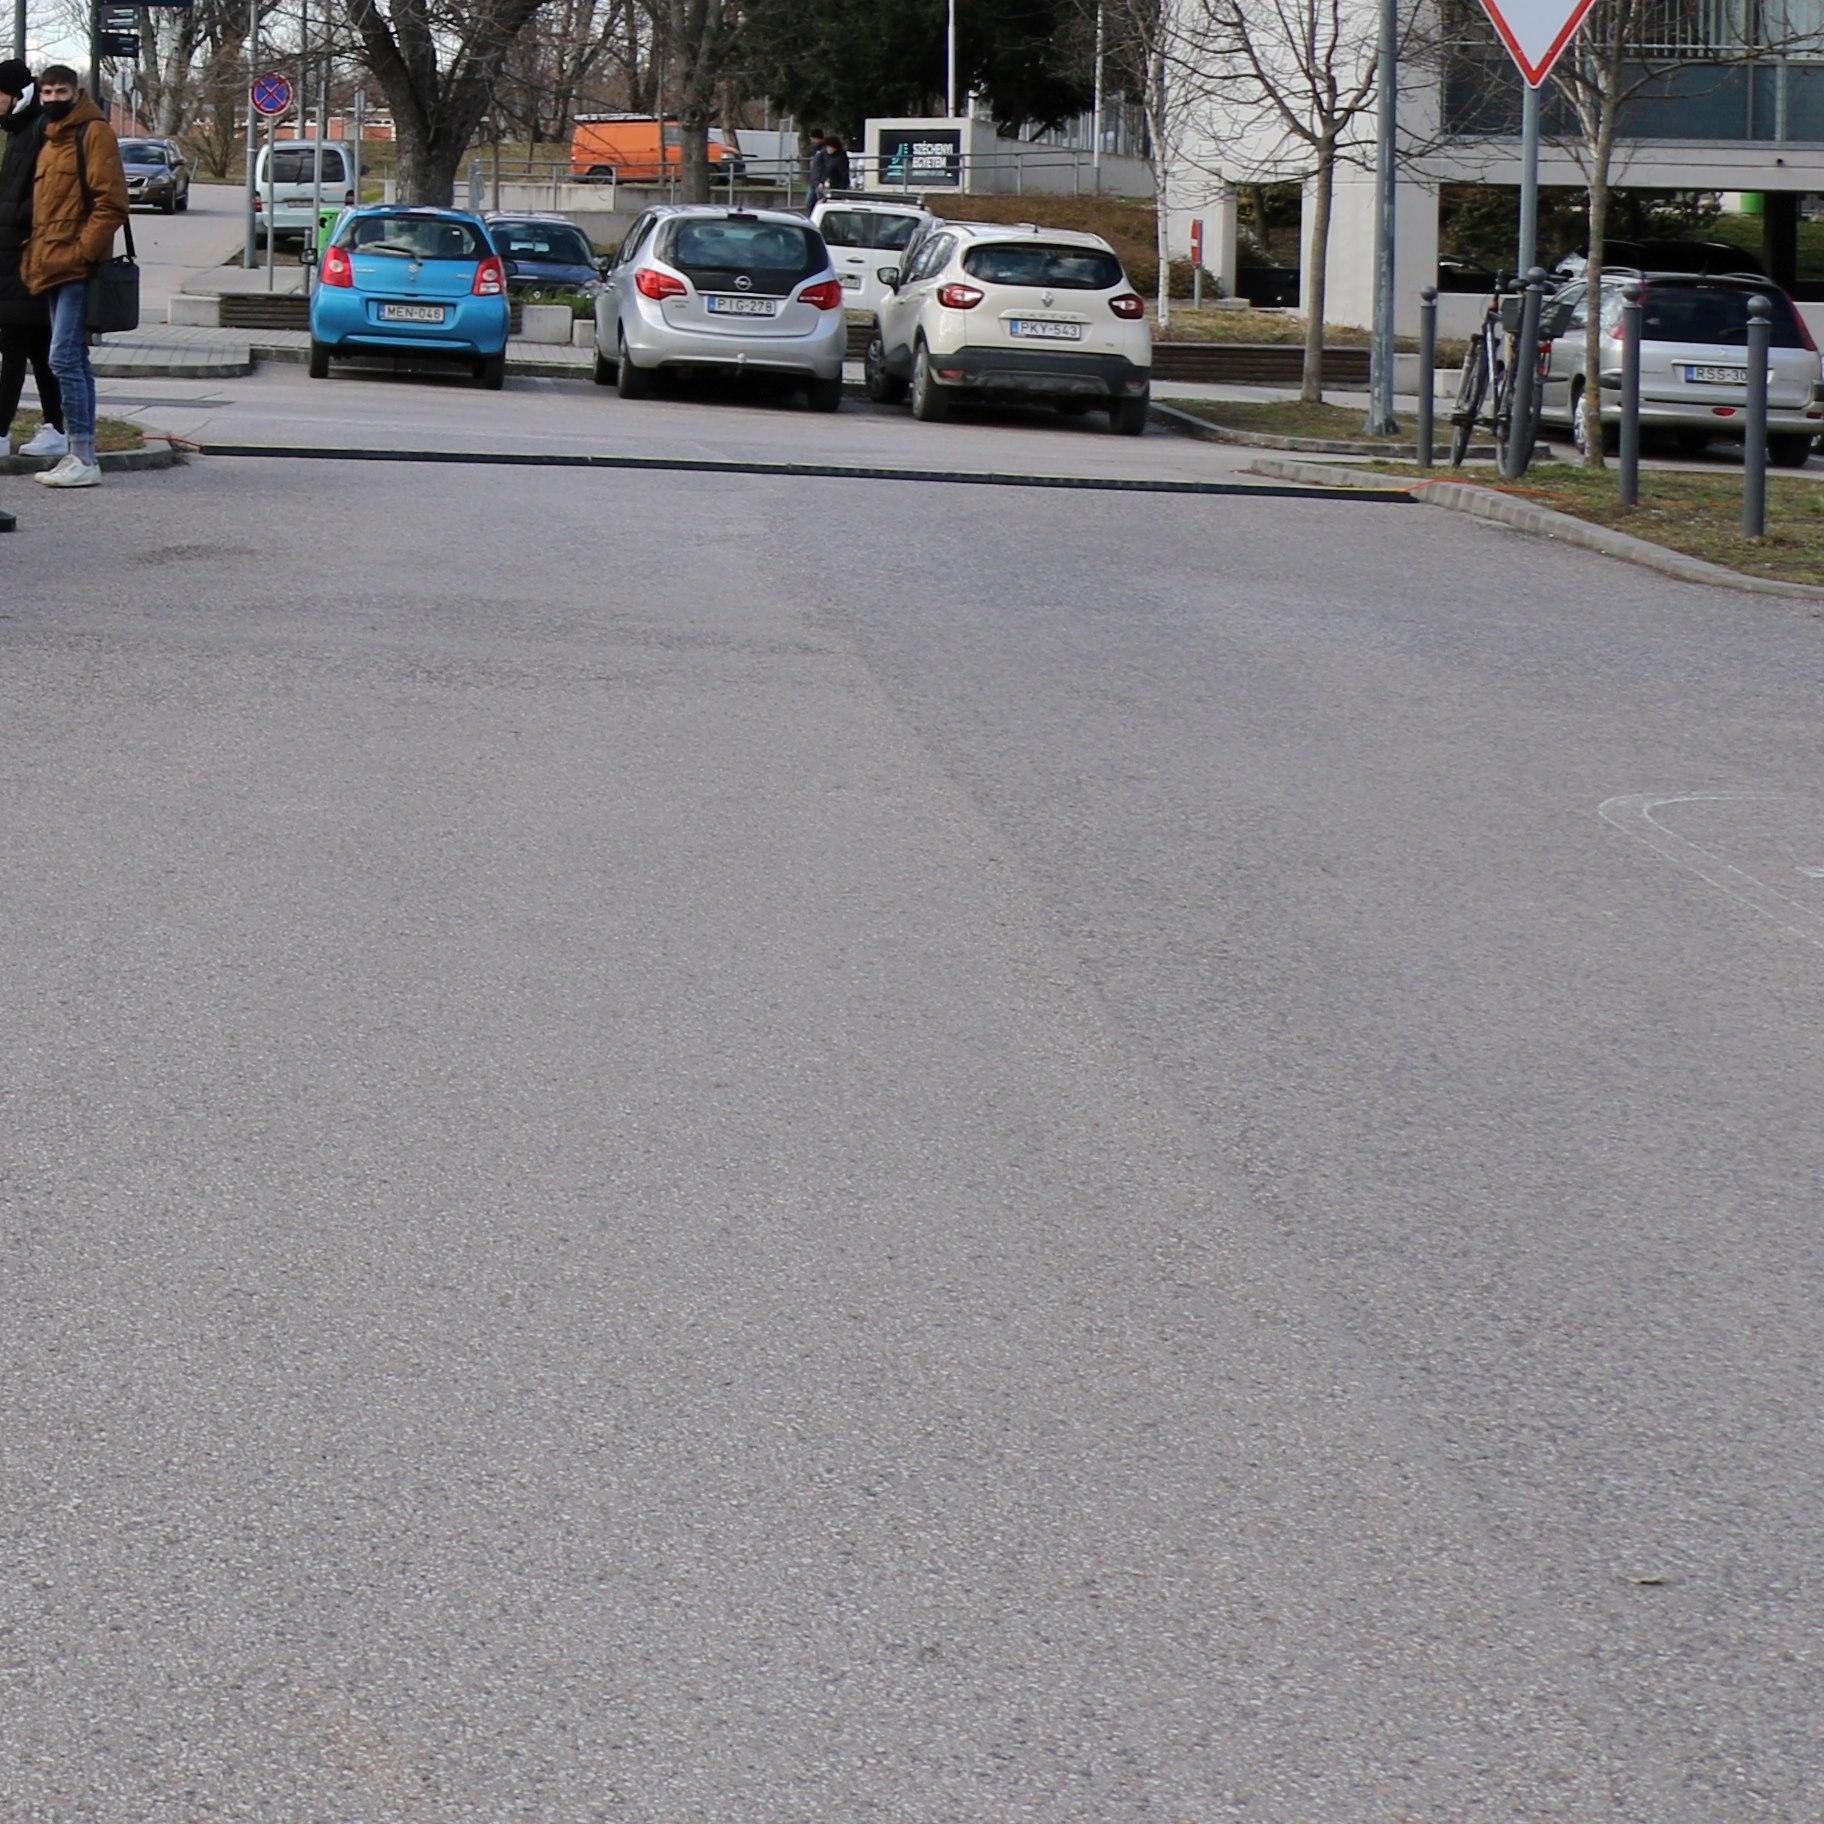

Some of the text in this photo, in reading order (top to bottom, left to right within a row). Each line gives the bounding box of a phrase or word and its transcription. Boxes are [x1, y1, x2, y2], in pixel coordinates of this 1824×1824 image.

[717, 299, 772, 312] PIG-278
[387, 307, 441, 319] MEN-046
[1020, 321, 1079, 336] PKY-543
[1695, 367, 1748, 382] RSS-30
